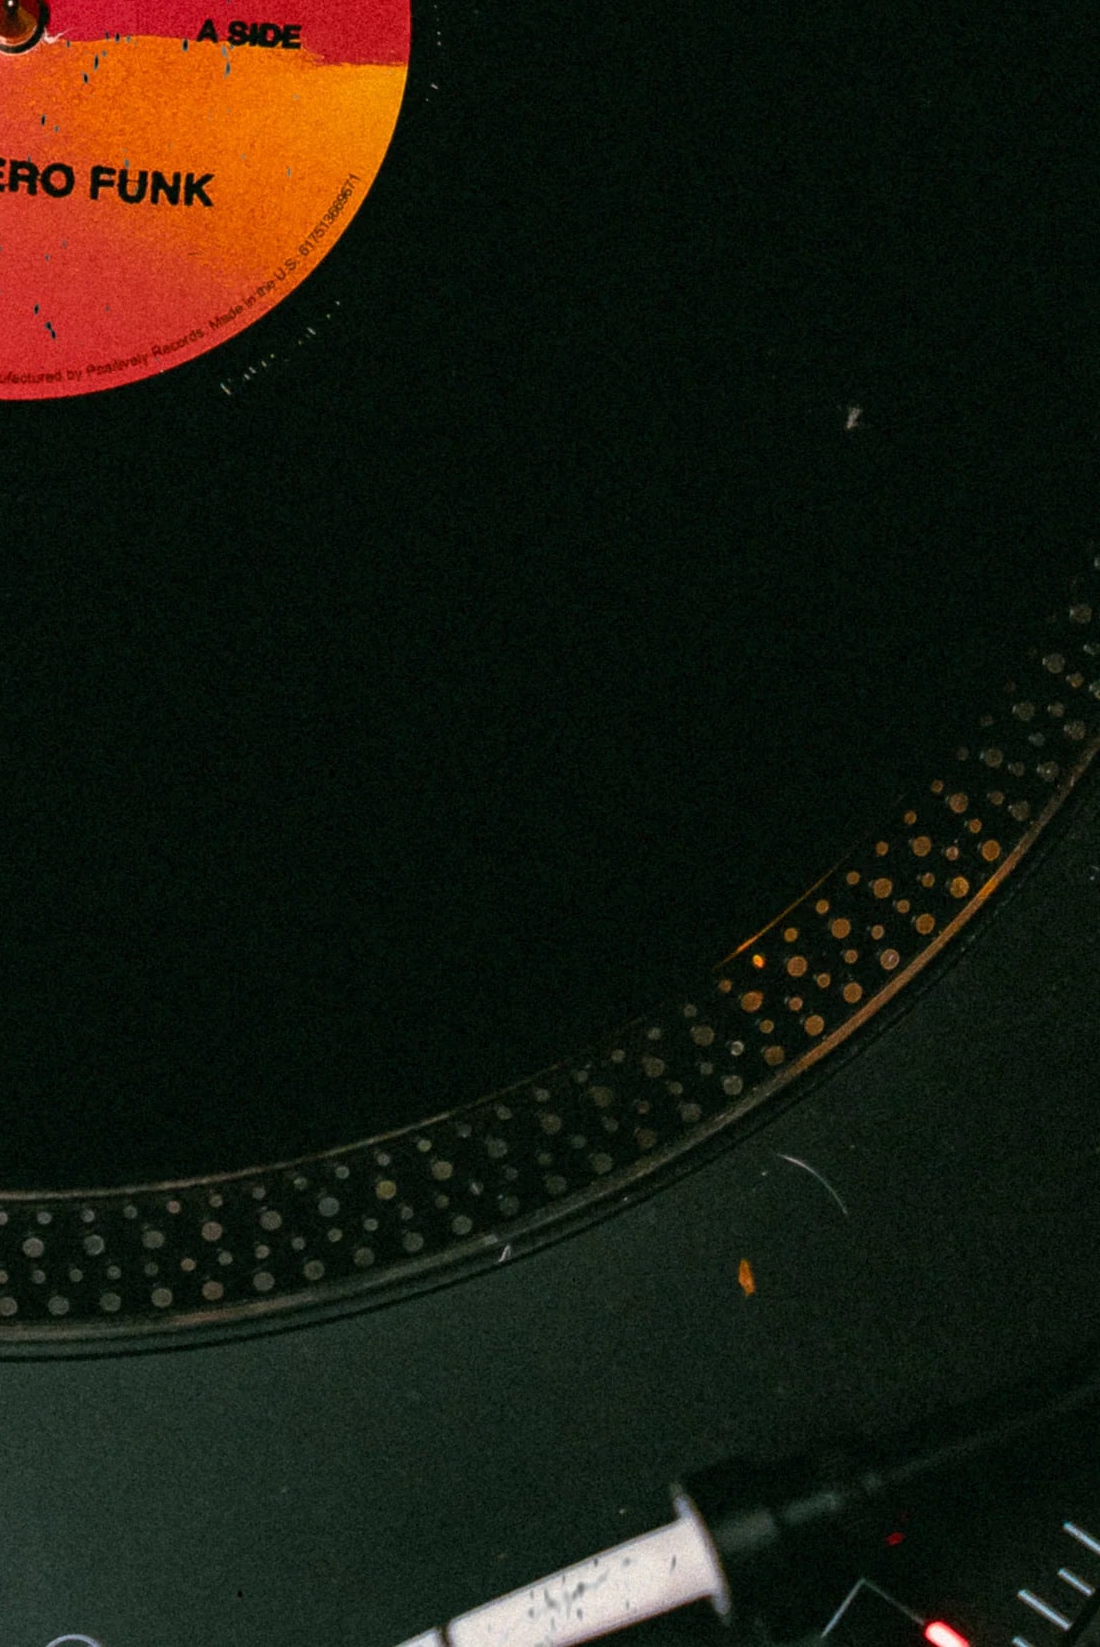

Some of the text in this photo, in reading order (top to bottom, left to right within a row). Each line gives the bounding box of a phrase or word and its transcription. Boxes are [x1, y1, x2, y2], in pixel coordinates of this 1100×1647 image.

[196, 19, 302, 49] A SIDE
[90, 165, 214, 207] FUNK
[66, 368, 83, 382] by
[208, 304, 244, 331] Made
[241, 294, 257, 309] in
[255, 279, 276, 298] the
